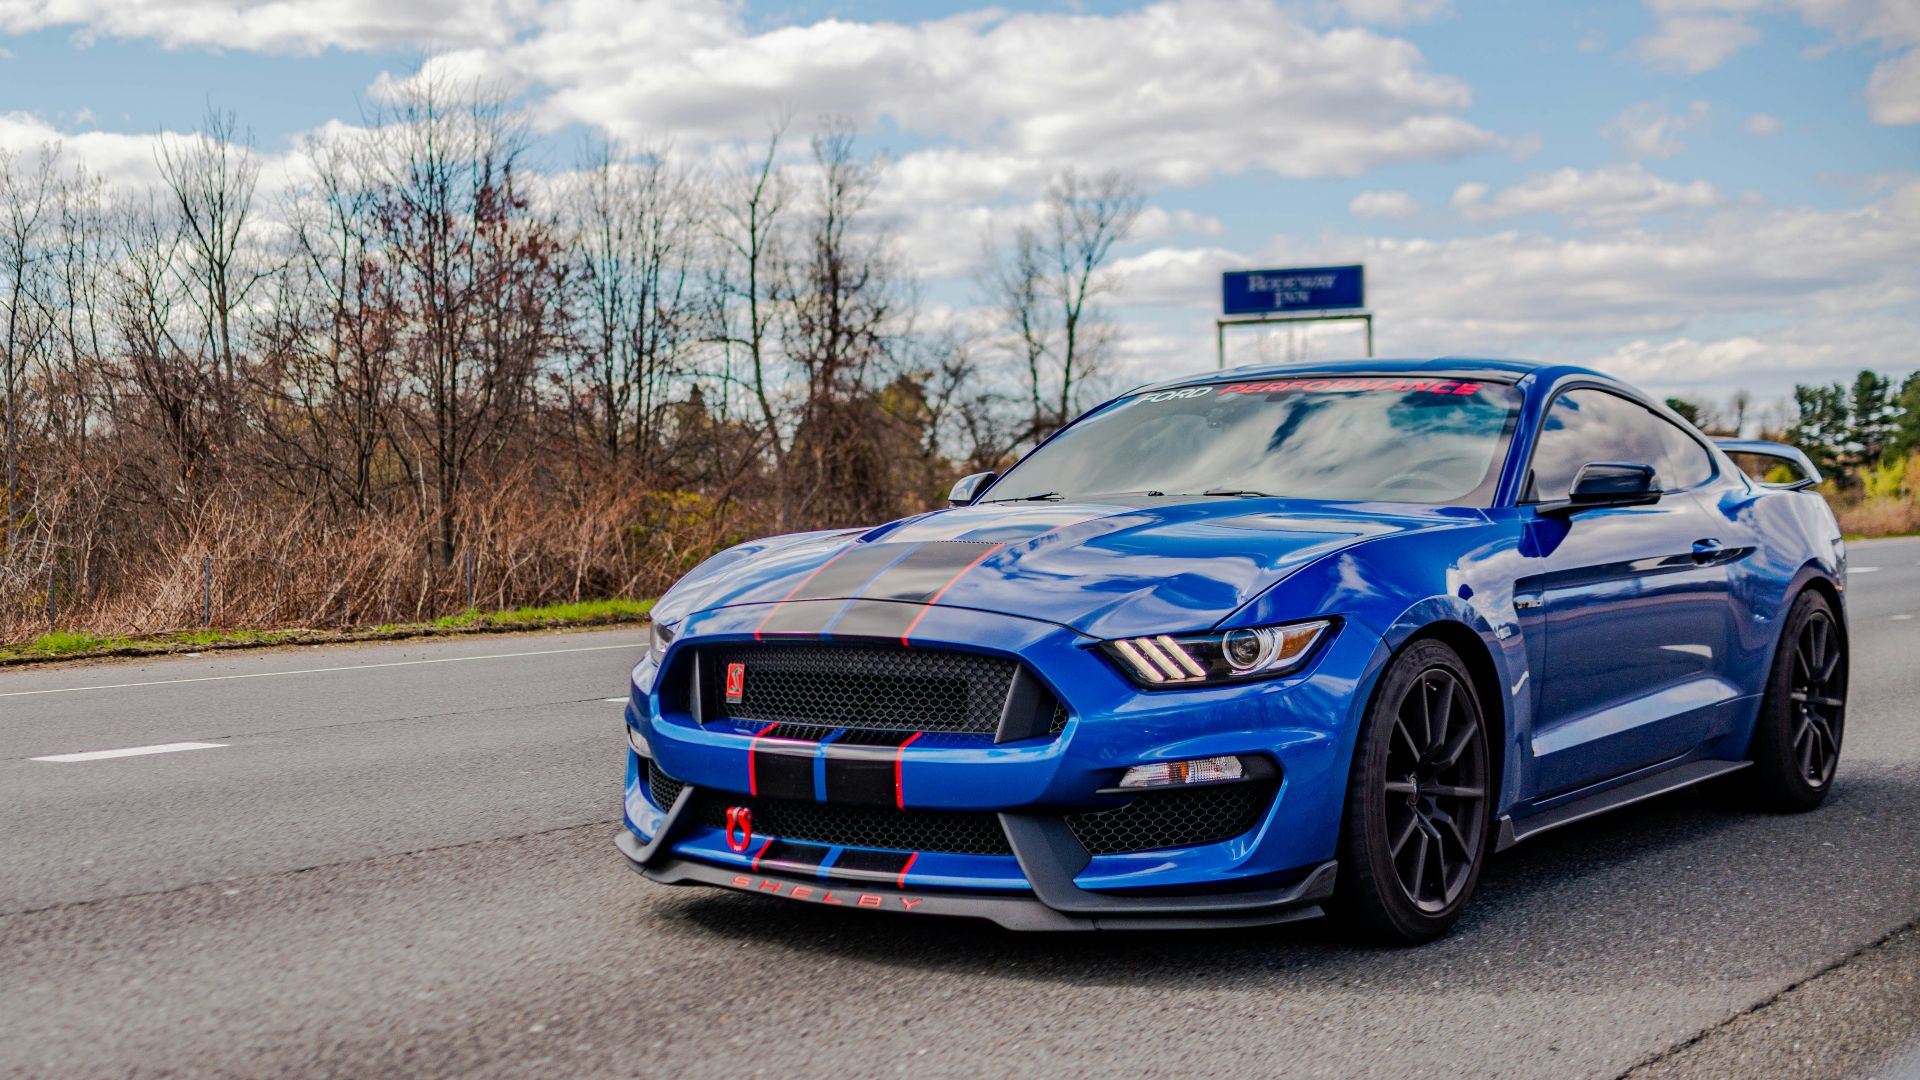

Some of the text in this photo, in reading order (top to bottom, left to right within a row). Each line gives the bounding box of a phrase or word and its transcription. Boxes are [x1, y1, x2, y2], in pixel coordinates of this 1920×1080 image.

[1135, 380, 1484, 405] FORD PERFORMANCE
[731, 875, 922, 911] SHELBY
